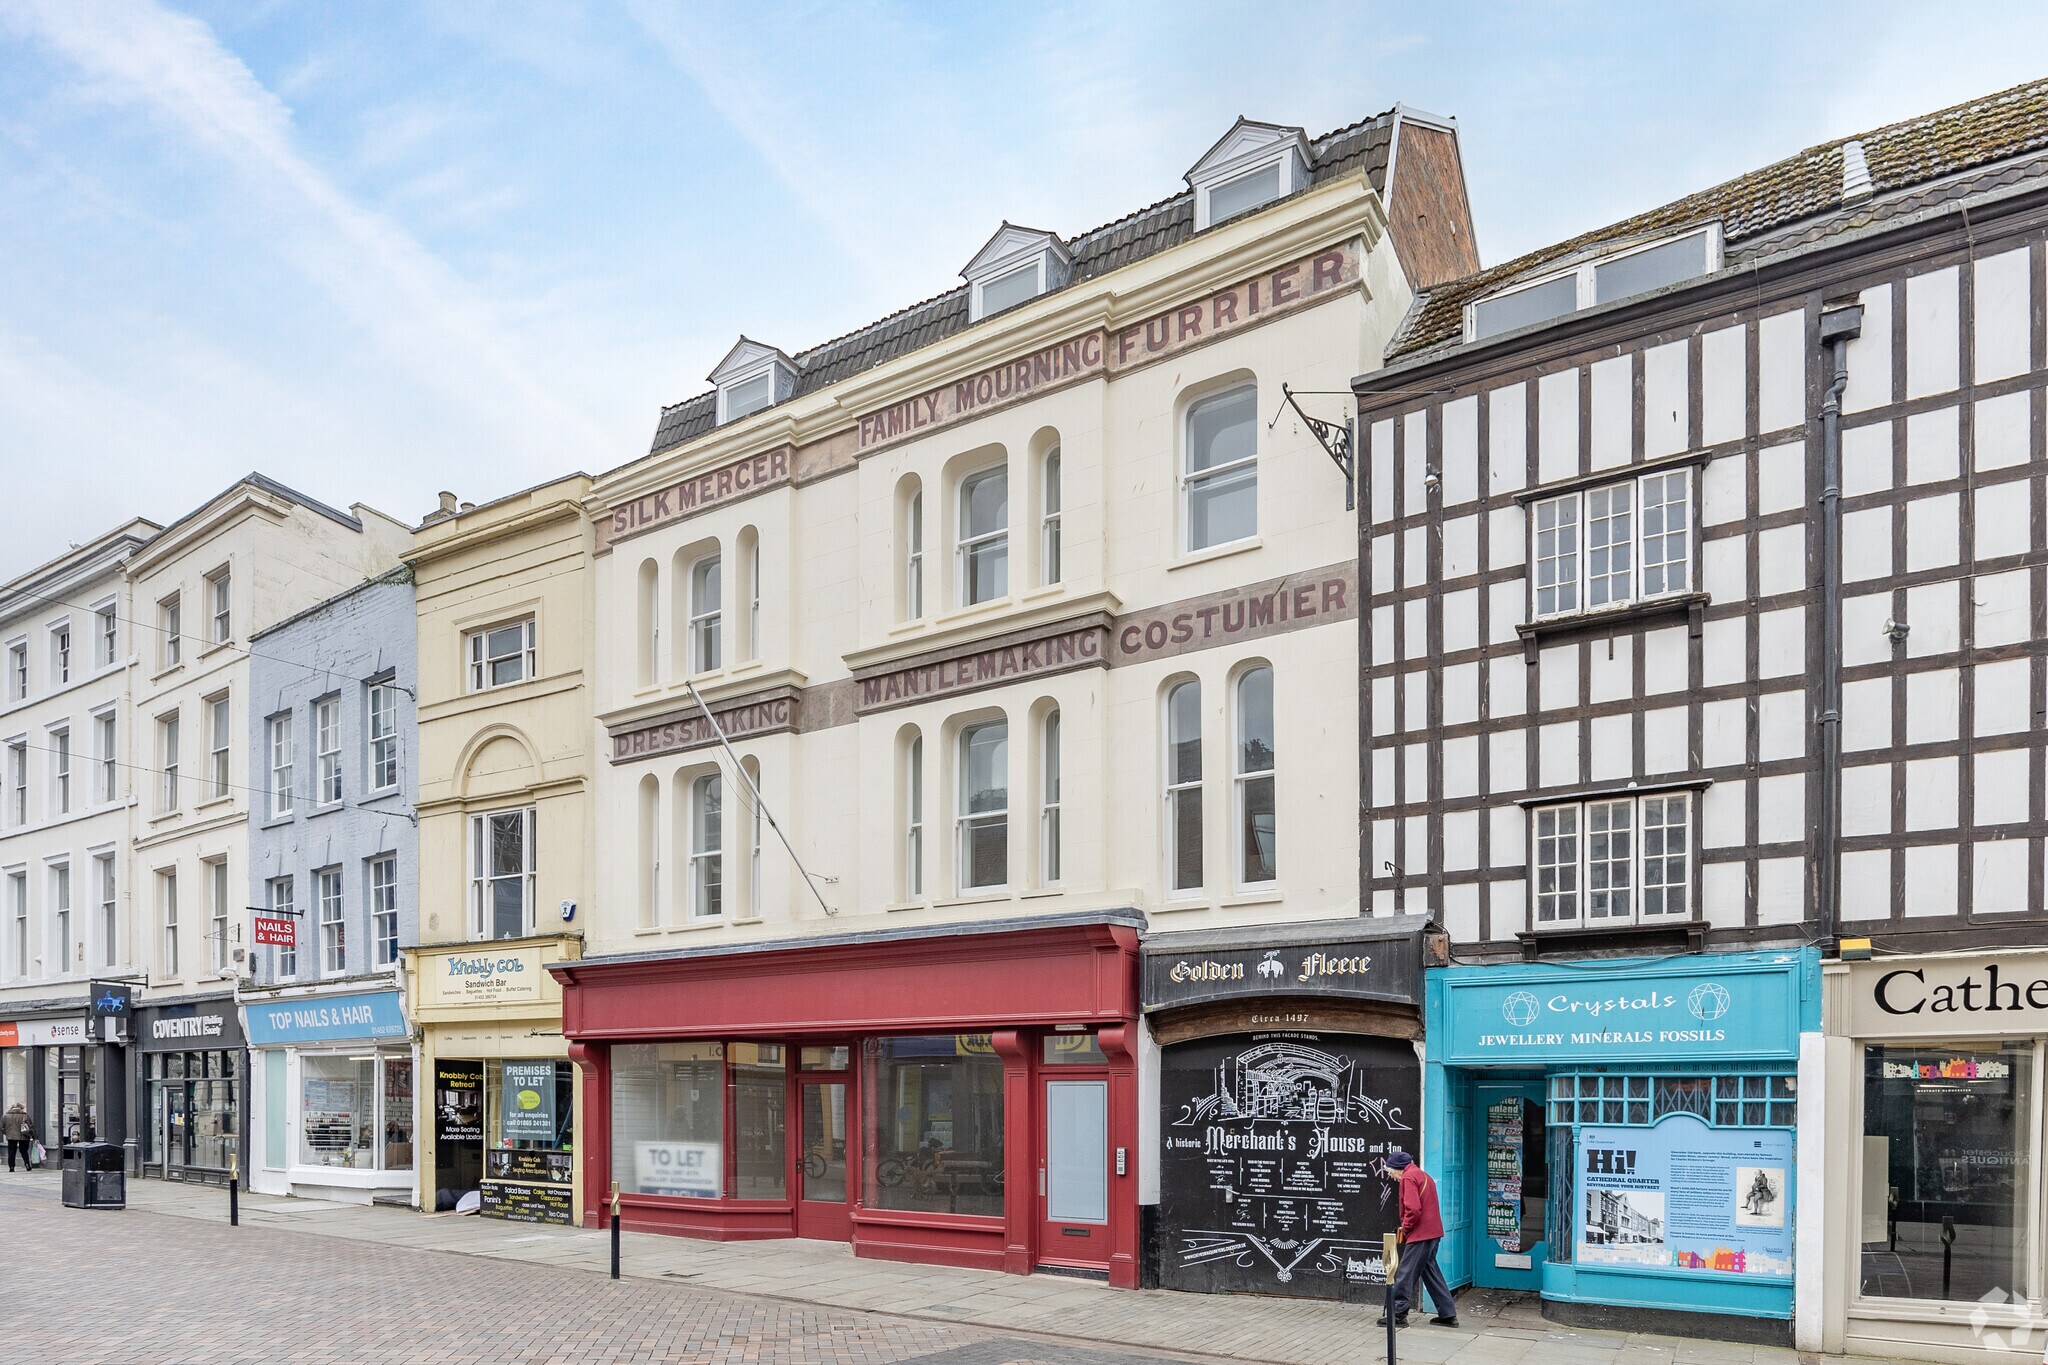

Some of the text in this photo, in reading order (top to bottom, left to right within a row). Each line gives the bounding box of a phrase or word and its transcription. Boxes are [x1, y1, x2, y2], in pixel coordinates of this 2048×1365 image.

[1119, 251, 1344, 365] FURRIER
[861, 335, 1101, 447] FAMILY MOURNING
[614, 450, 788, 533] SILK MERCER
[1120, 578, 1348, 655] COSTUMIER
[863, 630, 1097, 706] MANTLEMAKING
[617, 701, 788, 757] DRESSMAKING
[257, 921, 293, 933] NAILS
[257, 932, 294, 944] & HAIR
[1169, 952, 1372, 983] Golden Fleece
[465, 978, 507, 989] Sandwich Bar
[1873, 964, 2048, 1015] Cathe
[1547, 991, 1677, 1017] Crystals
[268, 1005, 374, 1030] TOP NAILS & HAIR
[1251, 1014, 1310, 1024] Circa 1497
[57, 1025, 79, 1036] sense
[152, 1016, 203, 1039] COVENTRY
[204, 1025, 221, 1037] Society
[1252, 1033, 1269, 1041] BEHIND
[1478, 1029, 1726, 1046] JEWELLERY MINERALS FOSSILS
[439, 1071, 468, 1080] Knobbly
[506, 1065, 552, 1076] PREMISES
[450, 1080, 476, 1088] Retreat
[513, 1076, 544, 1087] TO LET
[525, 1112, 549, 1120] enquiries
[460, 1126, 480, 1134] Seating
[1175, 1138, 1201, 1149] historic
[1204, 1126, 1297, 1156] Merchant's
[1307, 1127, 1365, 1159] House
[1369, 1144, 1384, 1153] and
[649, 1149, 705, 1168] TO LET
[1586, 1149, 1637, 1175] Hi!
[1627, 1177, 1660, 1185] QUARTER
[504, 1186, 531, 1195] Salad Boxes
[532, 1188, 545, 1196] Cakes
[553, 1189, 571, 1197] Chocolate
[484, 1195, 501, 1204] Panini's
[556, 1211, 569, 1219] Cakes
[1346, 1272, 1370, 1281] Cathedral
